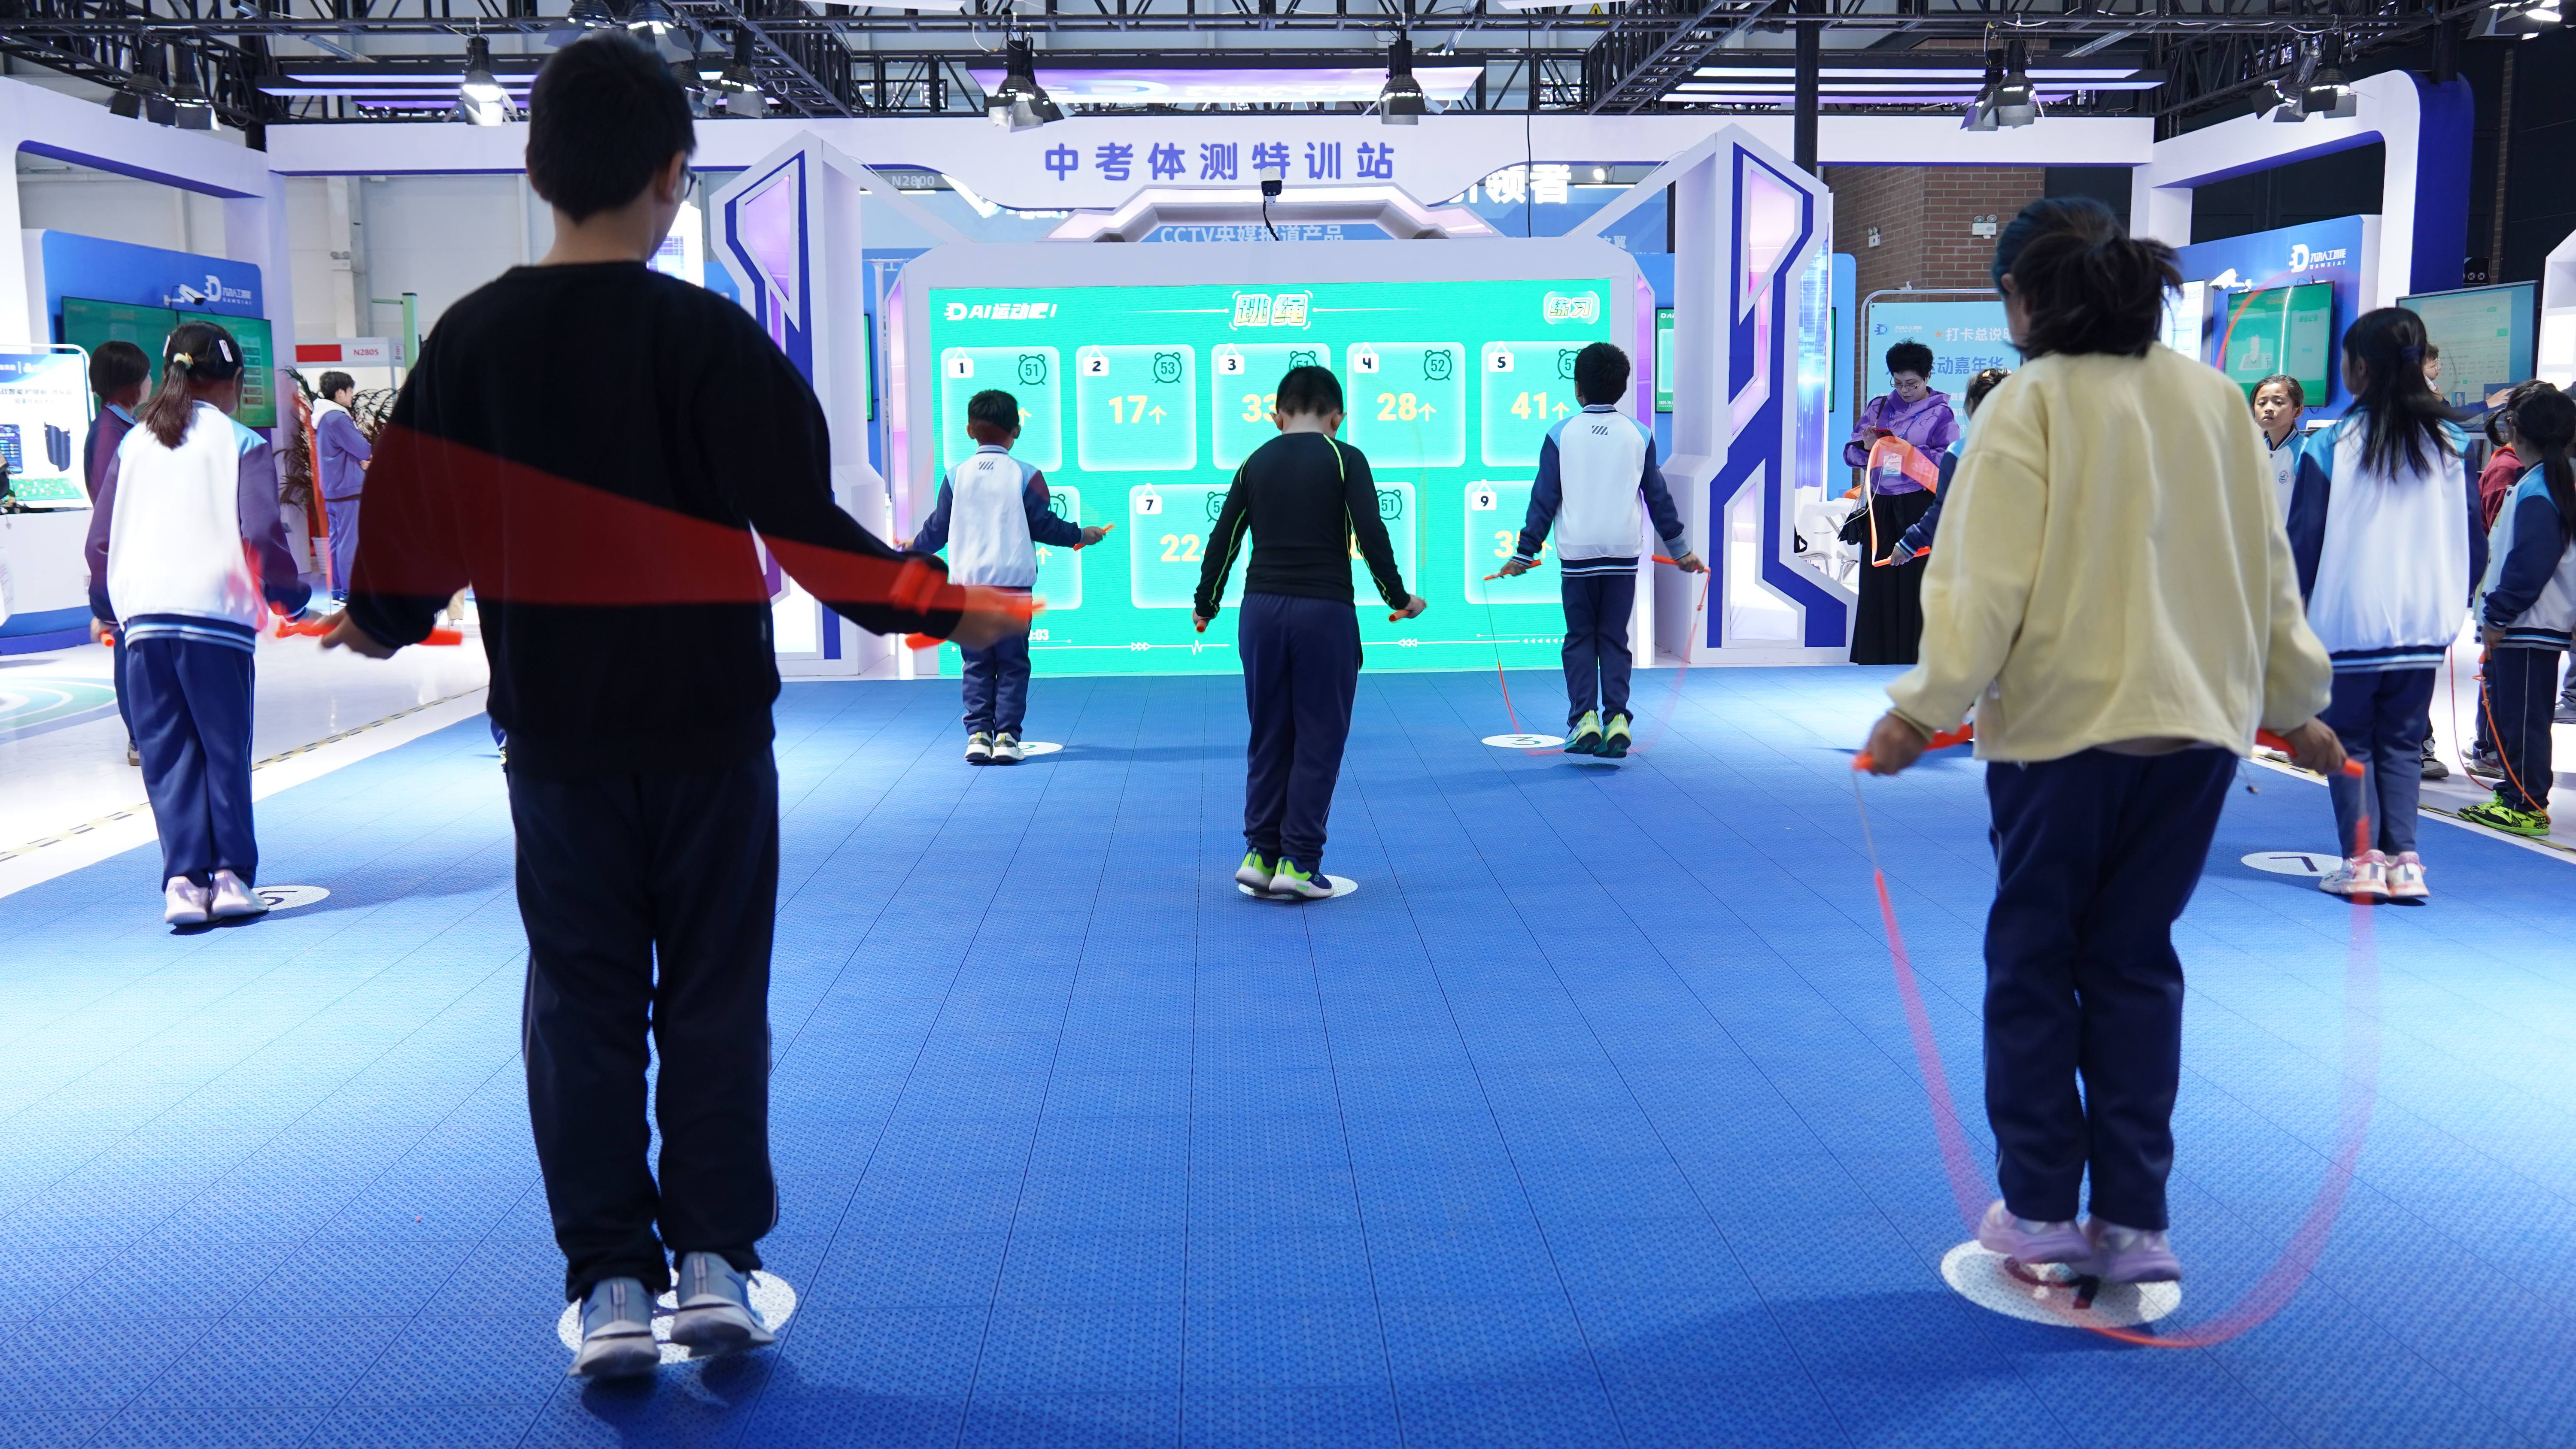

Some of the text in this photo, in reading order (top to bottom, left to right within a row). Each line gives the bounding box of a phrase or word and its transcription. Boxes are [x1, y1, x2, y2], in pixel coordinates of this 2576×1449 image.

[1045, 142, 1395, 180] 中考体测特训站
[892, 176, 935, 186] N2800
[1449, 164, 1571, 203] 领者
[1235, 295, 1306, 324] 跳绳
[1549, 299, 1591, 317] 练习
[959, 362, 964, 373] 1
[1092, 361, 1101, 372] 2
[1160, 362, 1175, 374] 53
[1228, 359, 1236, 370] 3
[1362, 358, 1372, 369] 4
[1431, 359, 1445, 372] 52
[1497, 357, 1506, 368] 5
[1025, 364, 1038, 376] 51
[1145, 499, 1154, 511] 7
[1381, 499, 1394, 511] 51
[1480, 495, 1489, 506] 9
[1506, 737, 1542, 746] 3
